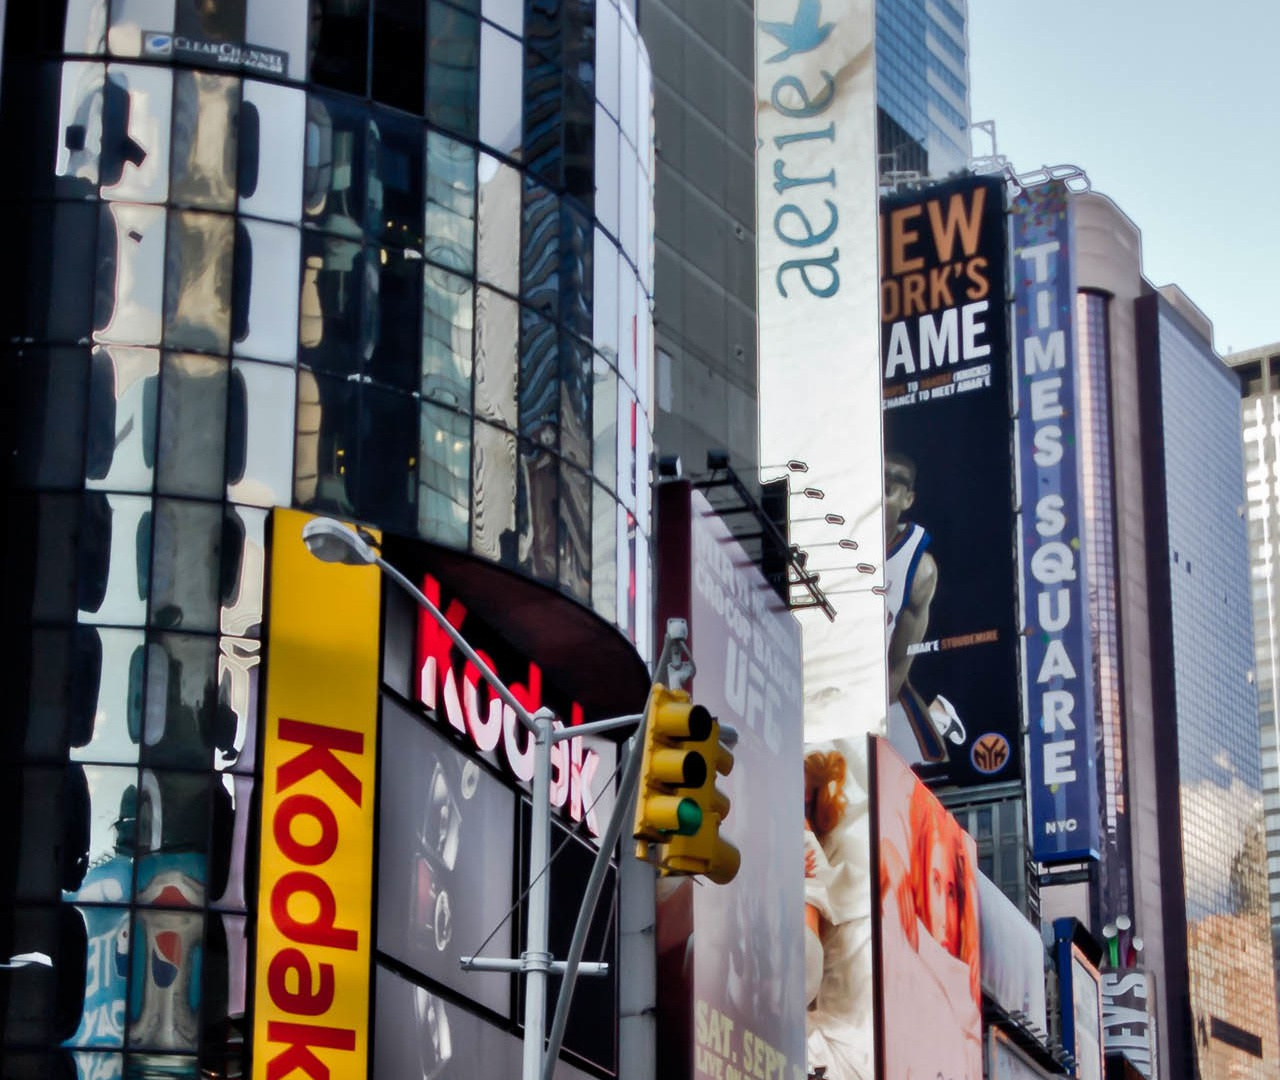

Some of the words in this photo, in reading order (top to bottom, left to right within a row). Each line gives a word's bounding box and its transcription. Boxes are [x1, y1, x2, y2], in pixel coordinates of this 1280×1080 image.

[771, 70, 841, 300] aerie
[880, 187, 988, 278] EW
[884, 300, 991, 379] AME
[1020, 241, 1066, 467] TIMES
[1031, 495, 1077, 786] SQUARE
[1045, 818, 1078, 836] NYC
[695, 999, 737, 1064] SAT.
